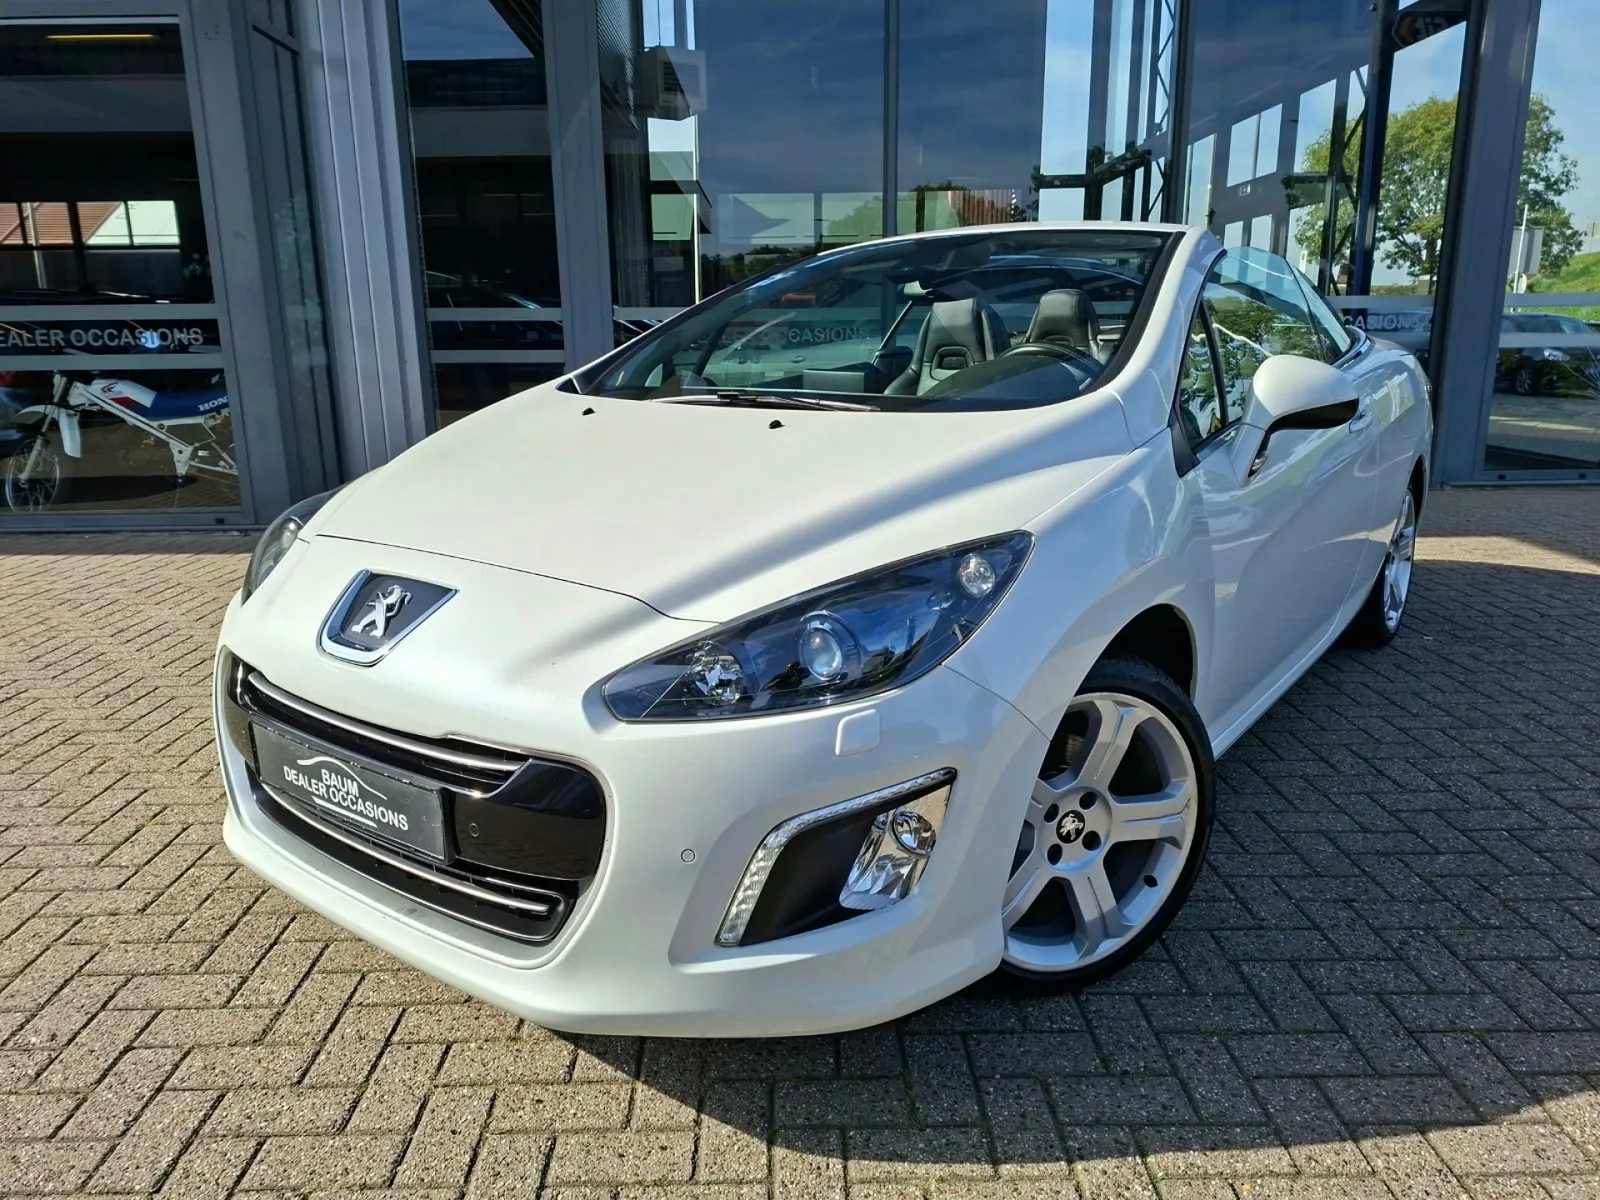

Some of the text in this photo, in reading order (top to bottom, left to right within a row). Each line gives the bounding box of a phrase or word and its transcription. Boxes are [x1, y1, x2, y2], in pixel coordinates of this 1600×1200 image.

[69, 327, 204, 347] OCCASIONS
[321, 768, 359, 797] BAUM
[283, 765, 409, 831] DEALER OCCASIONS
